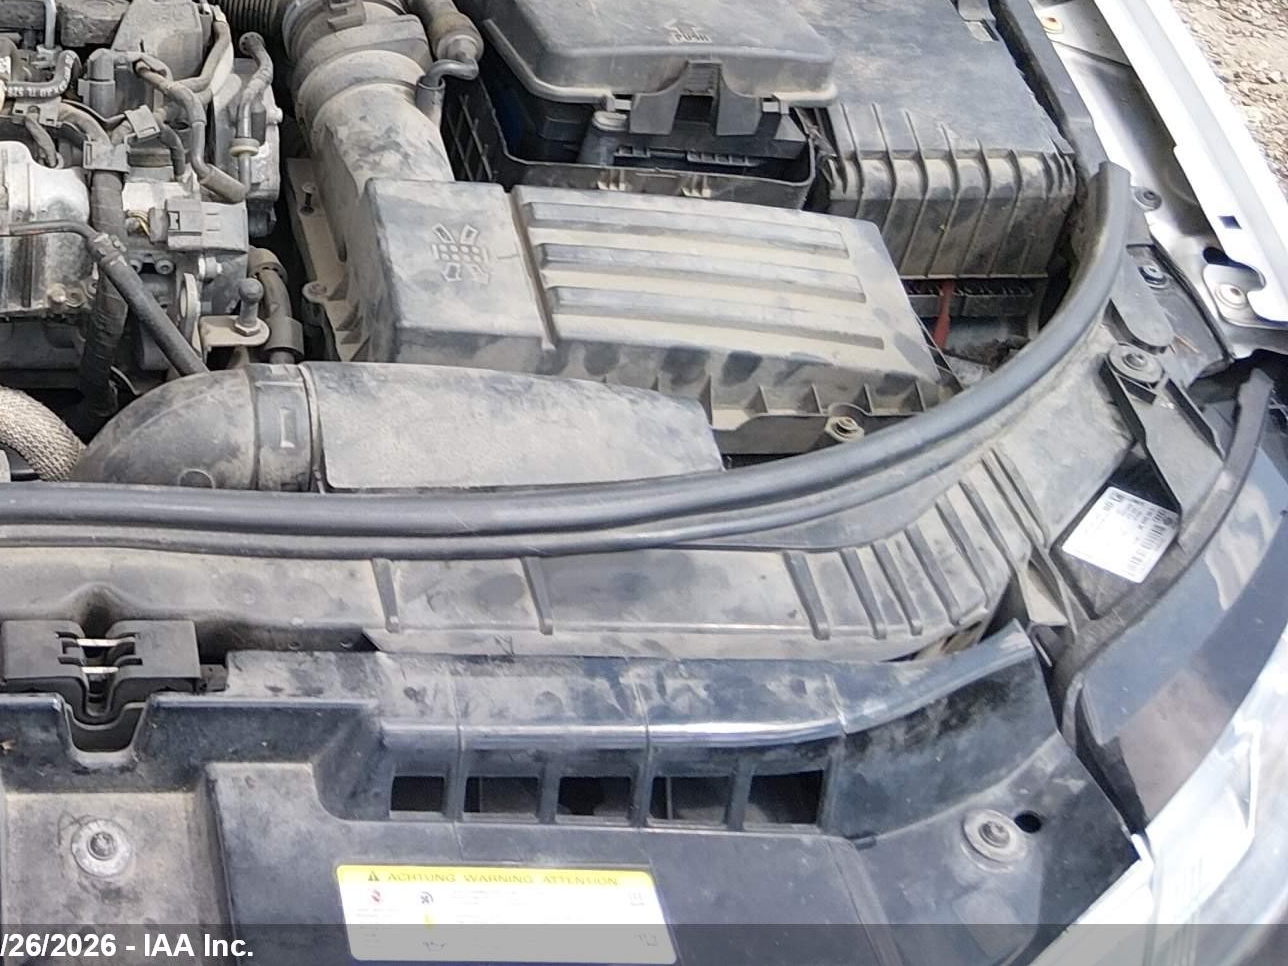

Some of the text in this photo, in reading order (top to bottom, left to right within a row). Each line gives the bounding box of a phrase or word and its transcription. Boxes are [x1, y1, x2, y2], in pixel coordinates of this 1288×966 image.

[387, 873, 619, 886] ACHTUNG WARNING ATTENTION
